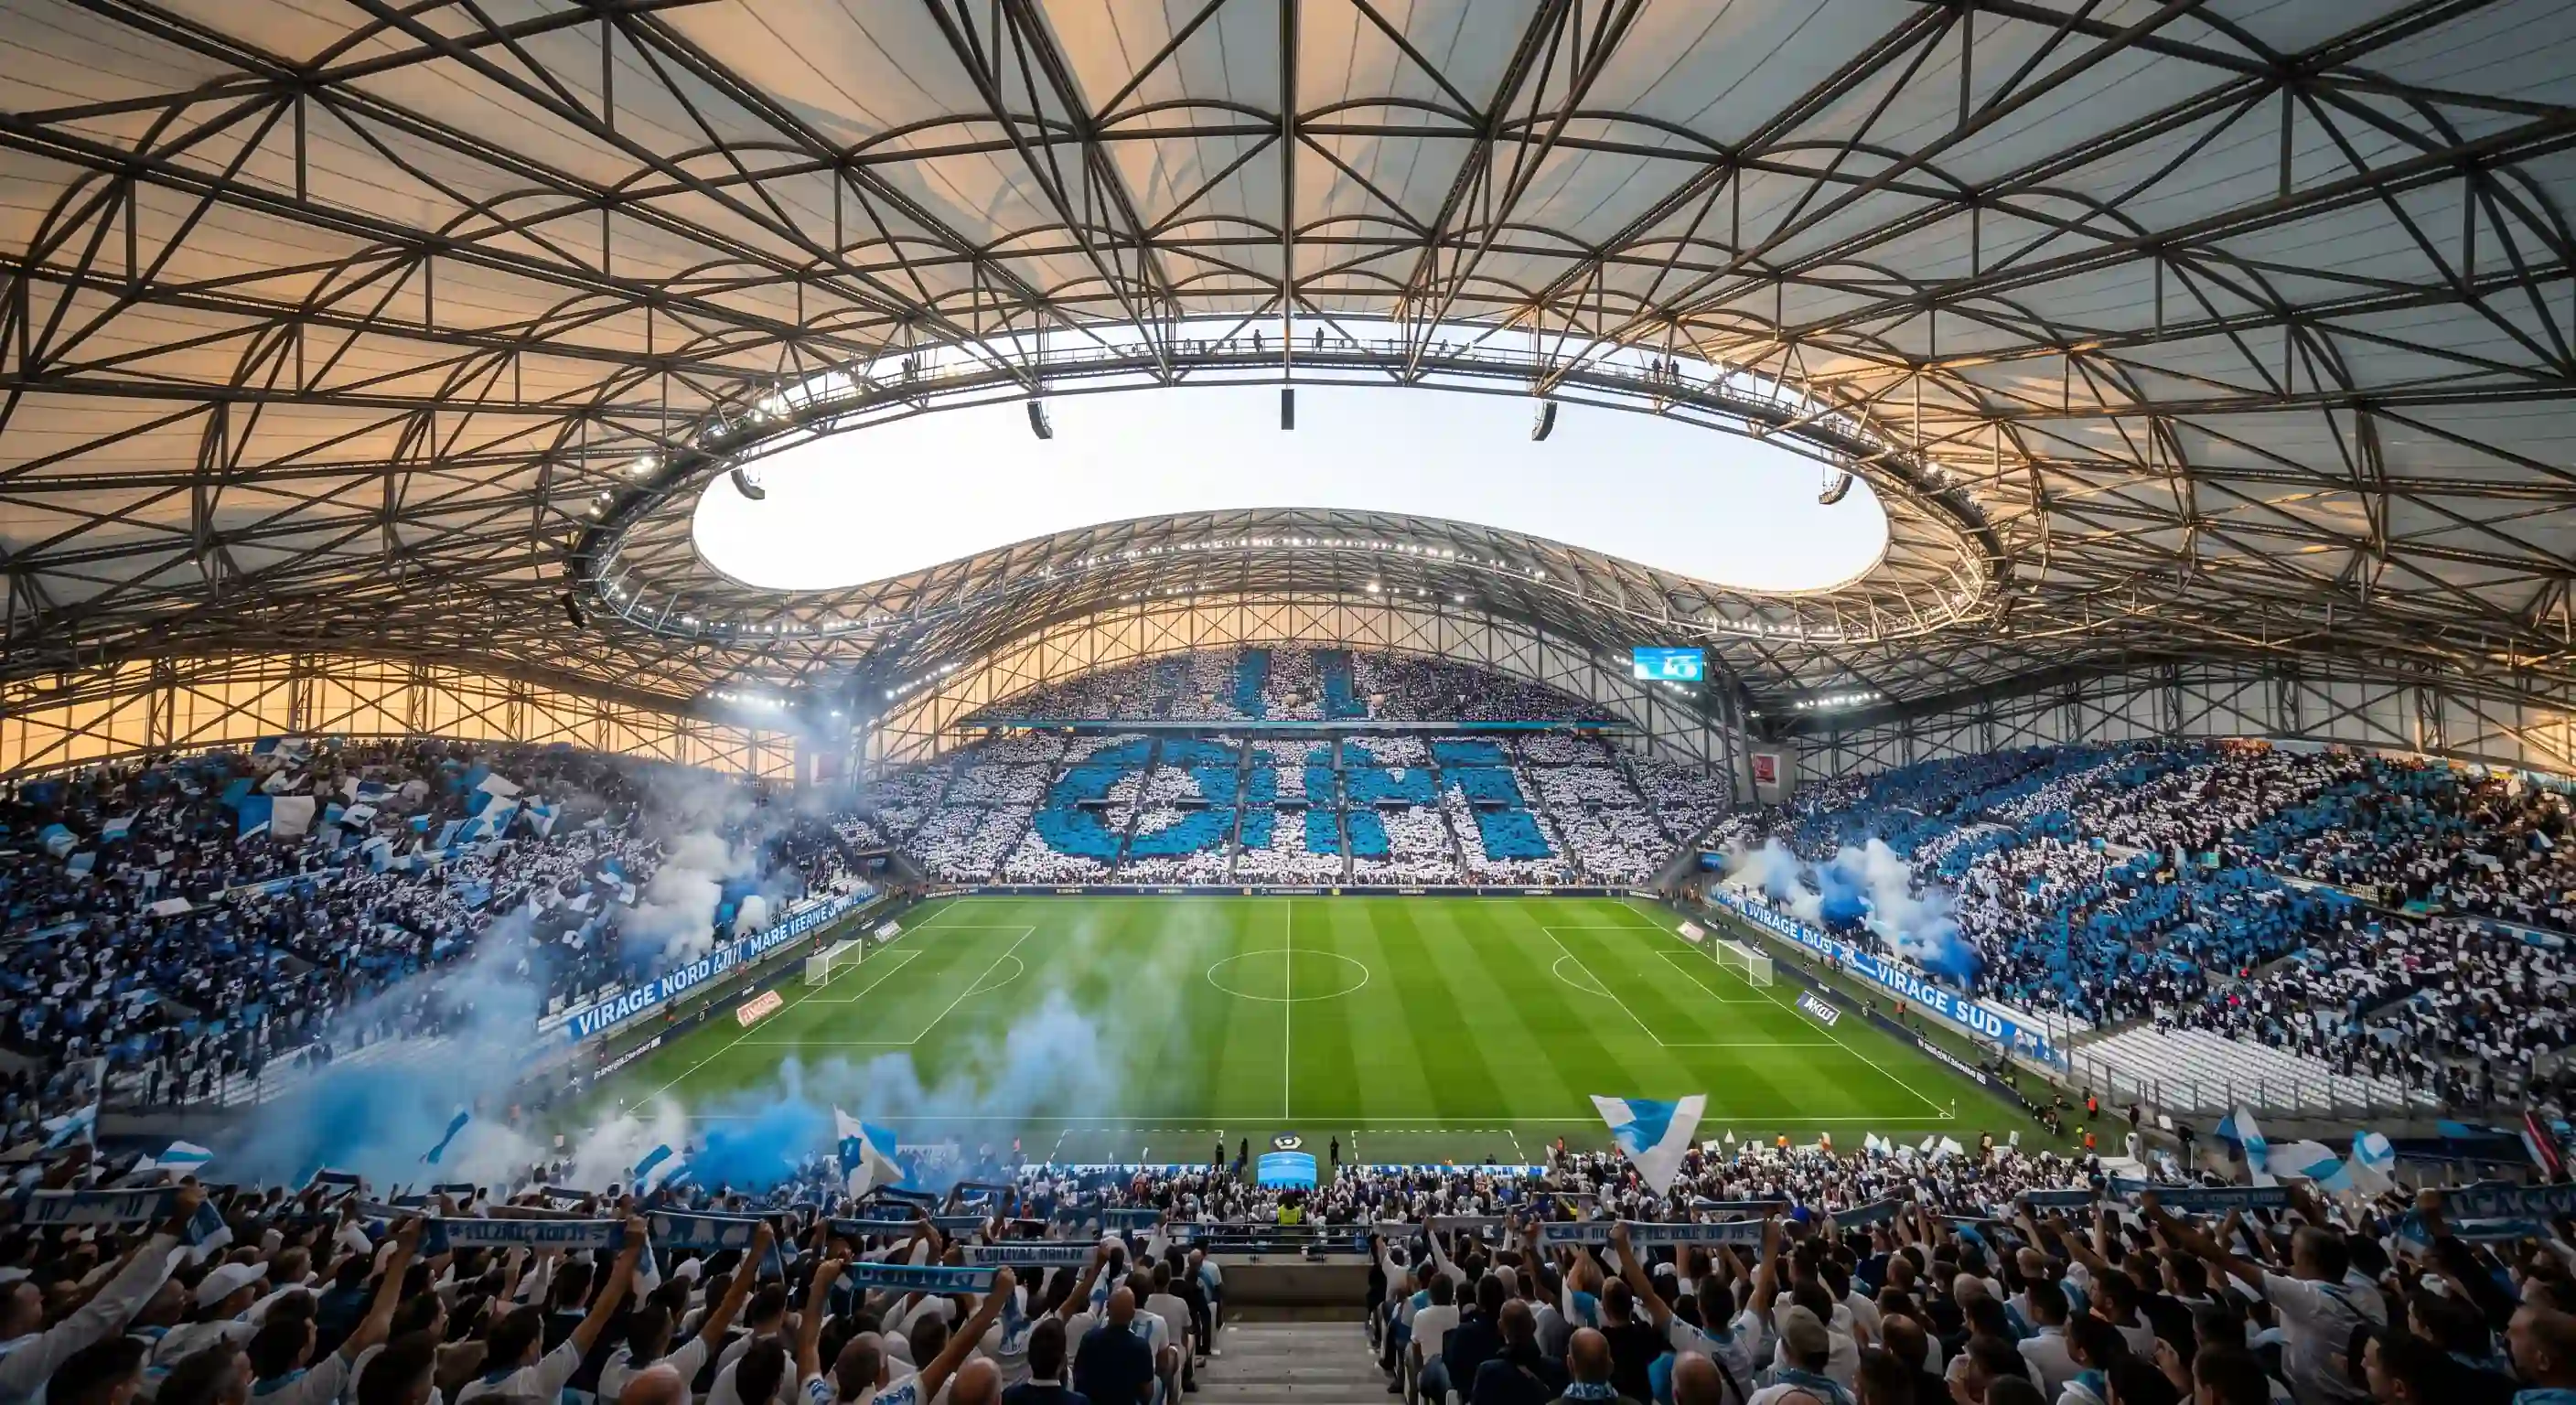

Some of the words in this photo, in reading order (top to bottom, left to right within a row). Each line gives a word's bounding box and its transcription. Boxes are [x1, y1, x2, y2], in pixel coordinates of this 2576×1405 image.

[579, 983, 656, 1035] VIRAGE
[661, 960, 710, 997] NORD
[1876, 961, 1950, 1013] VIRAGE
[1955, 1000, 2002, 1037] SUD
